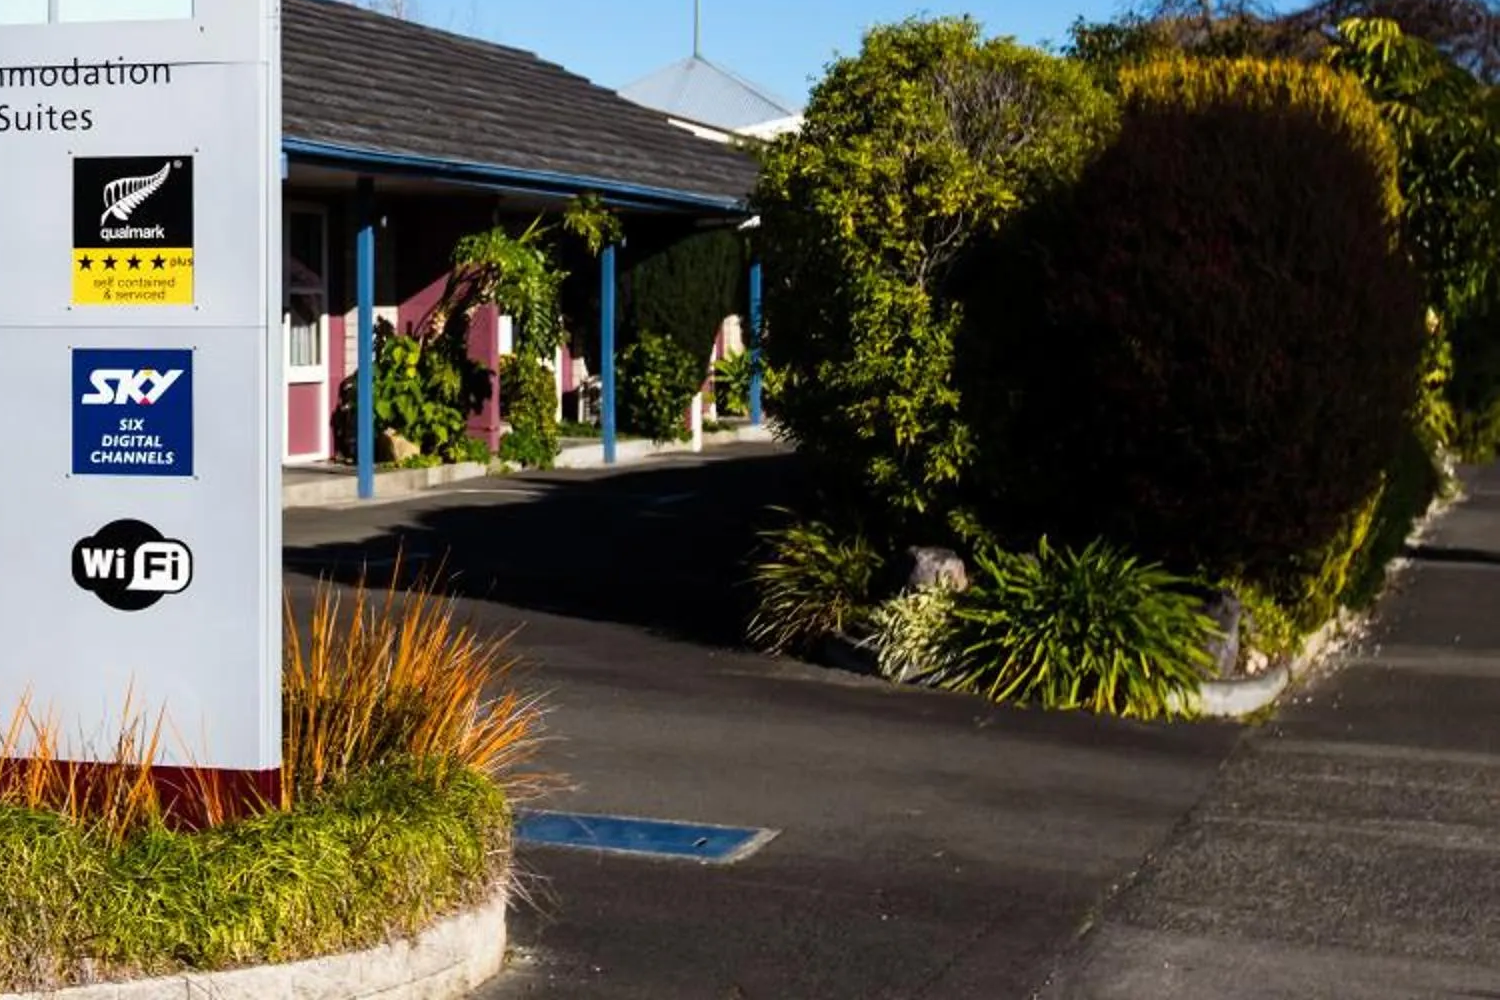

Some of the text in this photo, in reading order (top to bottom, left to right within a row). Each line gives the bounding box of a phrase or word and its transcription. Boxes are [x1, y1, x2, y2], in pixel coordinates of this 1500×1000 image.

[100, 224, 165, 242] qualmark
[169, 257, 193, 269] plus
[117, 276, 176, 288] contained
[115, 289, 166, 301] serviced
[81, 368, 185, 405] SKY
[119, 418, 145, 432] SIX
[101, 434, 163, 448] DIGITAL
[90, 450, 175, 465] CHANNELS
